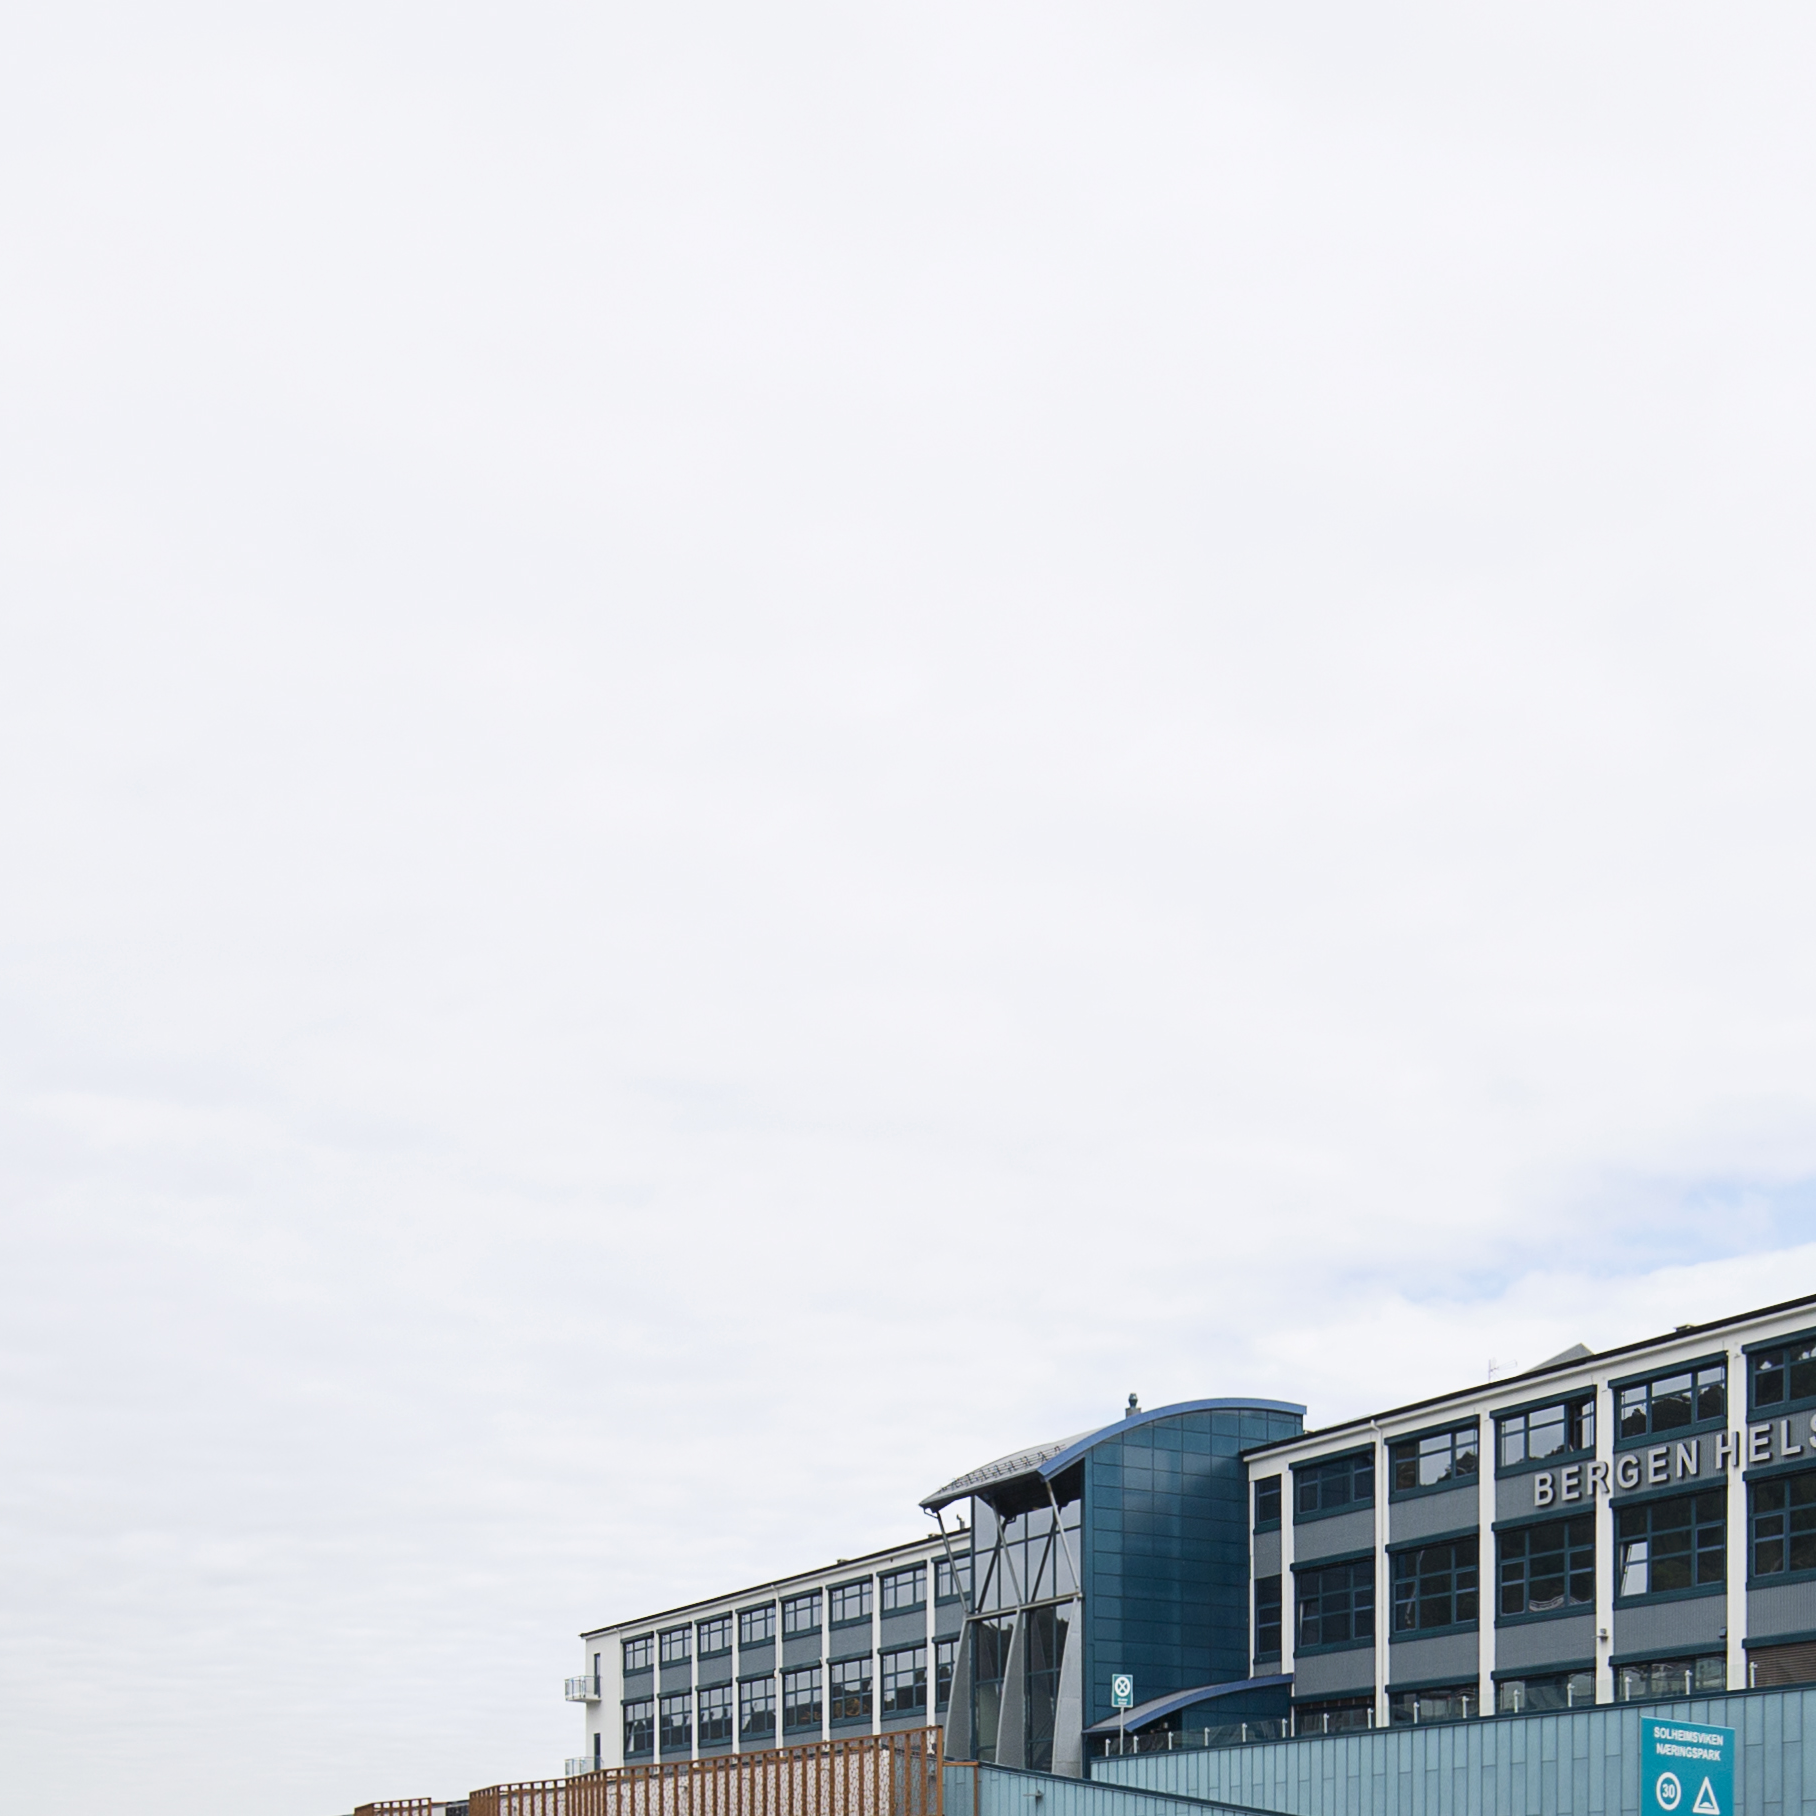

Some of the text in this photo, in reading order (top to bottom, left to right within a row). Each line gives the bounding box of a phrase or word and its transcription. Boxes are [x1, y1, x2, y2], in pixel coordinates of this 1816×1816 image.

[1534, 1439, 1700, 1507] BERGEN
[1653, 1726, 1724, 1746] SOLHEIMSVIKEN
[1656, 1743, 1721, 1761] NÆRINGSPARK
[1662, 1784, 1675, 1798] 30
